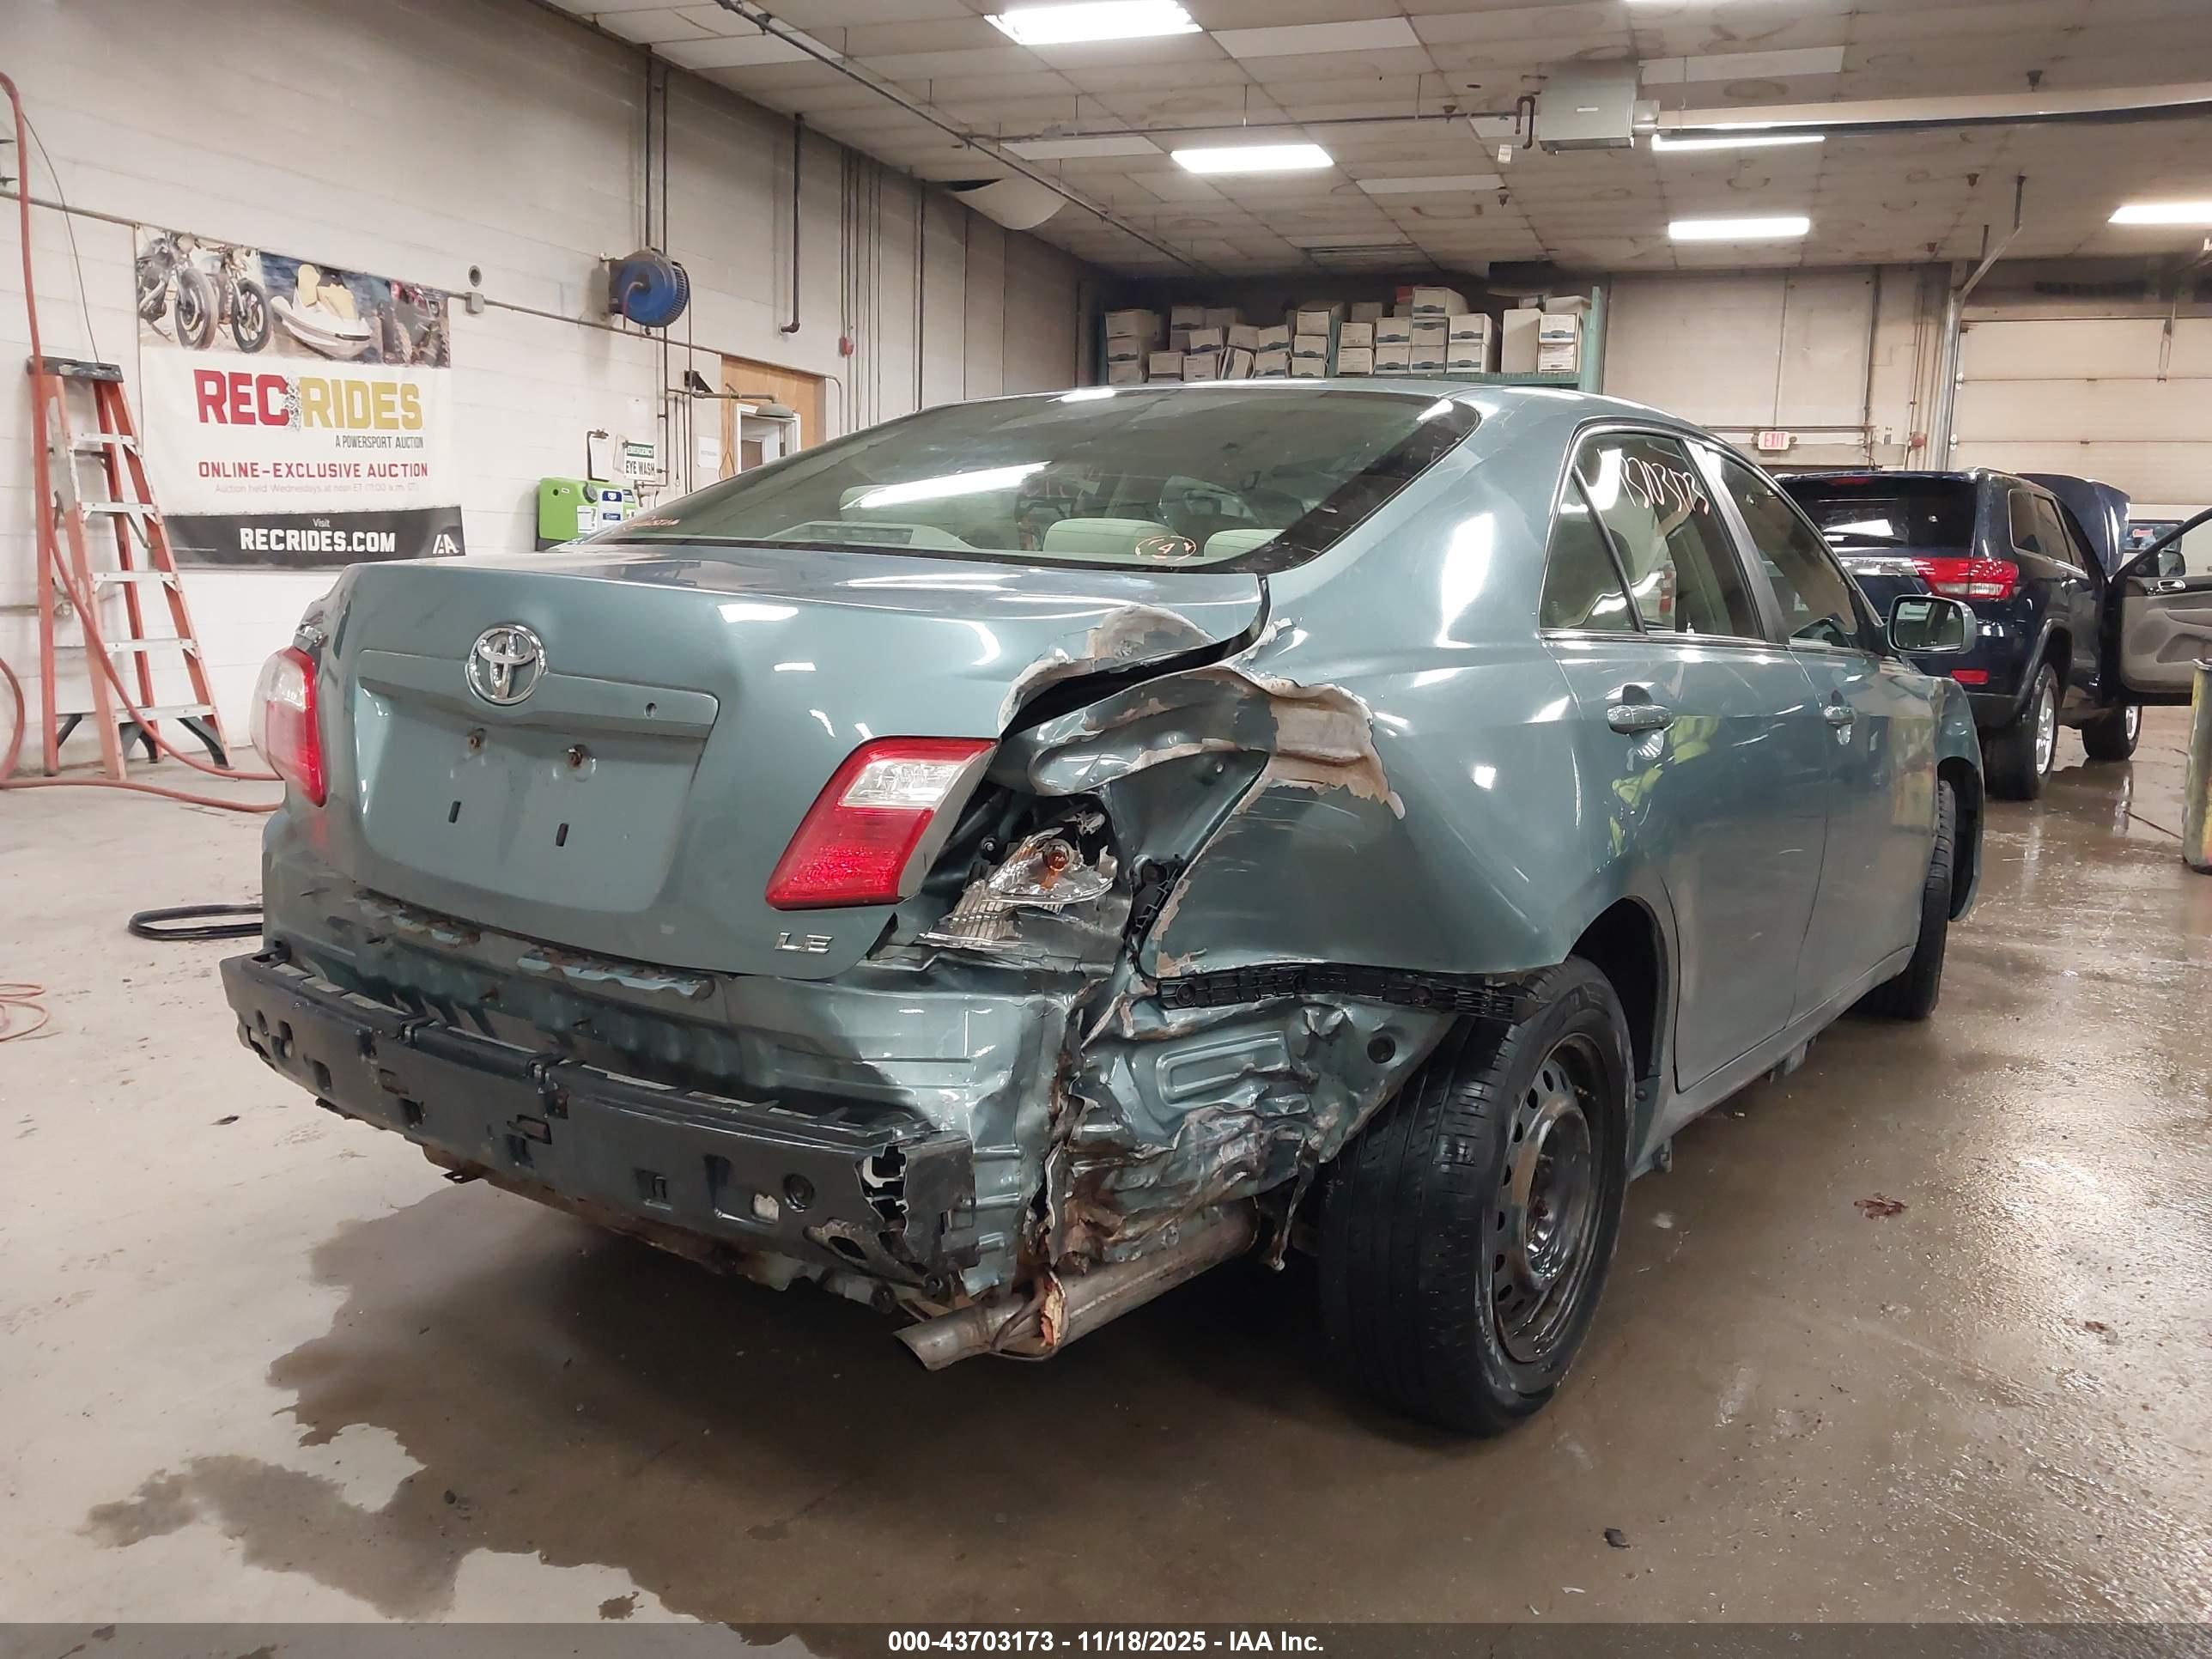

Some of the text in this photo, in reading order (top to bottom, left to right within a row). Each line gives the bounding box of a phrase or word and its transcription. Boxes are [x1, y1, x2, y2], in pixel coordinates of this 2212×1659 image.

[192, 368, 423, 430] REC RIDES
[335, 434, 424, 449] A POWERSPORT AUCTION
[1764, 432, 1786, 447] EXIT
[198, 461, 428, 478] ONLINE-EXCLUSIVE AUCTION
[625, 459, 655, 477] EYE WASH
[216, 483, 246, 493] Auction
[248, 483, 268, 493] held
[270, 483, 322, 495] Wednesdays
[312, 518, 331, 528] Visit
[239, 526, 397, 553] RECRIDES.COM
[774, 931, 834, 955] LE
